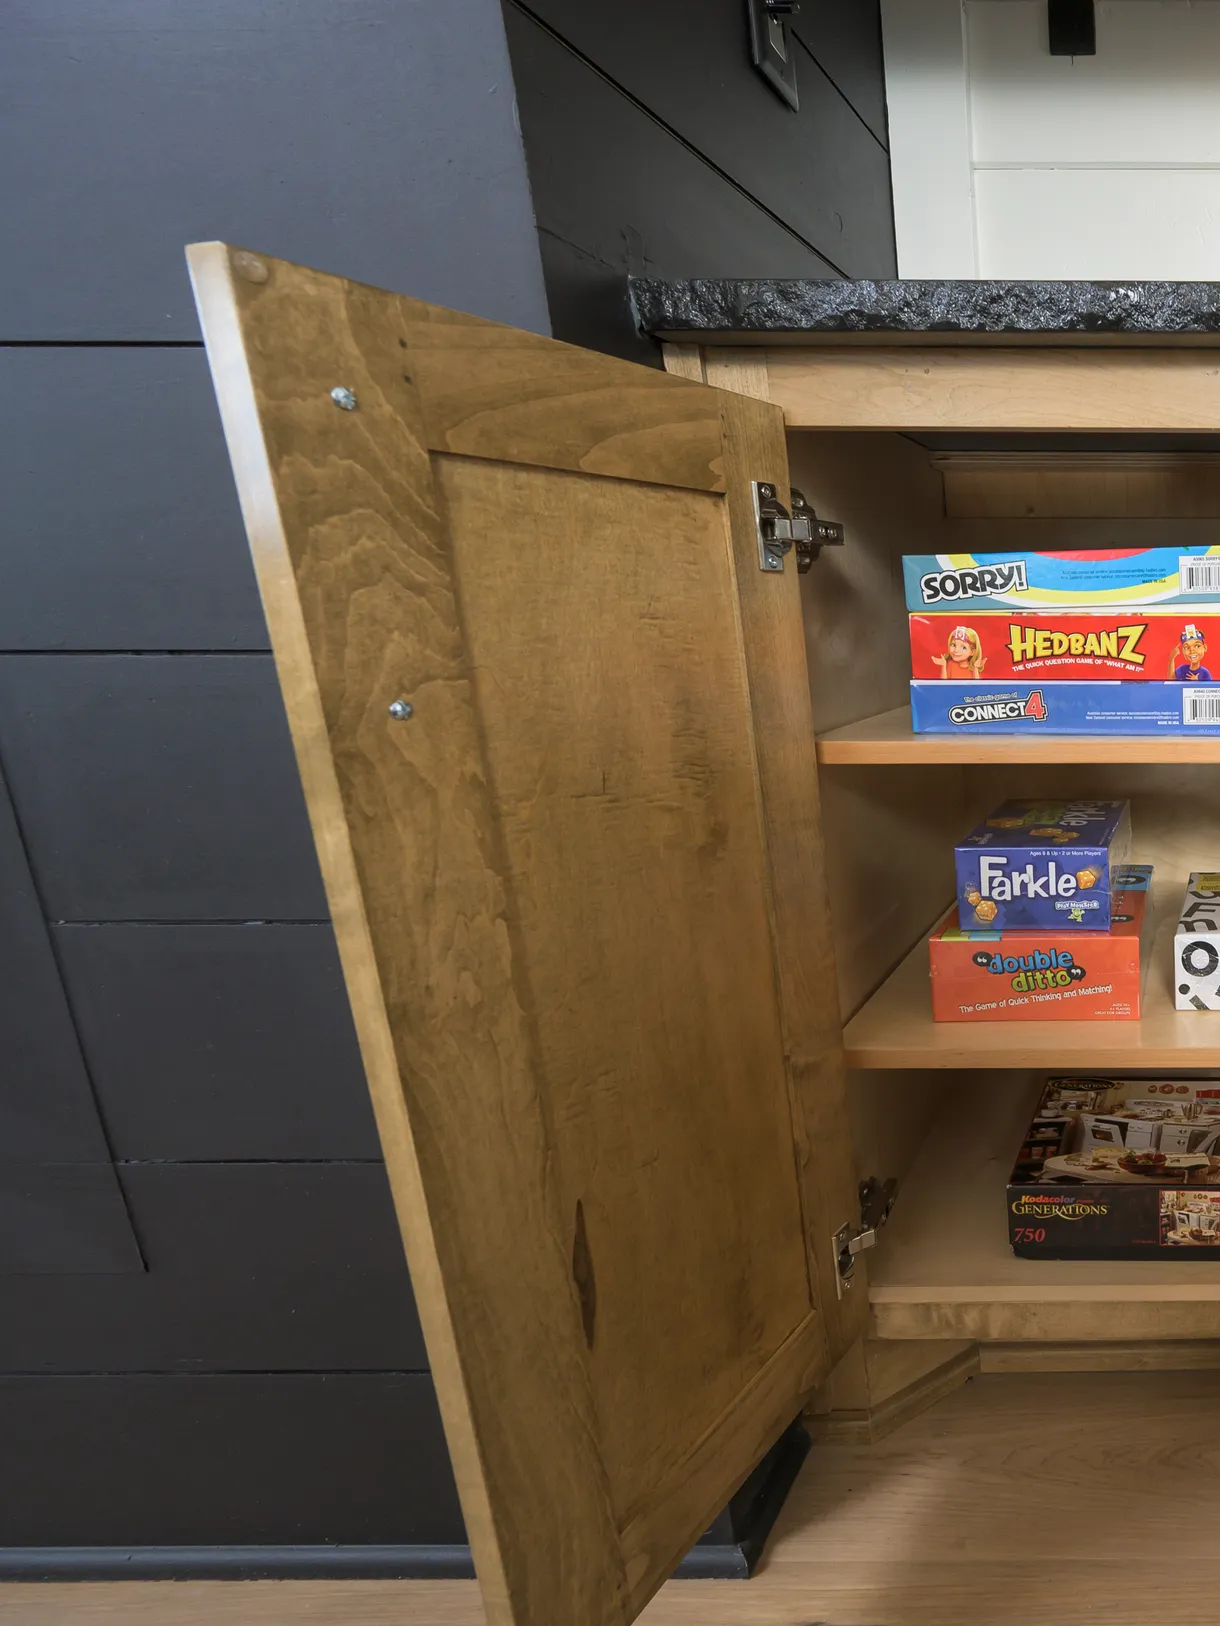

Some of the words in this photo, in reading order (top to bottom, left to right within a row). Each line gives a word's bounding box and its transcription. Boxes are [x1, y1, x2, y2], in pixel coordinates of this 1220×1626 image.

[922, 563, 1026, 601] SORRY!
[1005, 624, 1147, 665] HEDBANZ
[1012, 664, 1025, 672] THE
[1025, 661, 1044, 669] QUICK
[1045, 658, 1076, 666] QUESTION
[951, 702, 1026, 722] CONNECT
[1025, 692, 1045, 719] 4
[979, 855, 1077, 901] Farkle
[959, 1005, 973, 1013] The
[975, 1002, 997, 1011] Game
[999, 999, 1007, 1007] of
[1008, 996, 1029, 1006] Quick
[1030, 992, 1062, 1003] Thinking
[1063, 990, 1077, 998] and
[1078, 984, 1113, 997] Matching!
[1011, 1201, 1108, 1220] GENERATIONS
[1021, 1195, 1076, 1203] Kodacolor
[1013, 1228, 1046, 1242] 750
